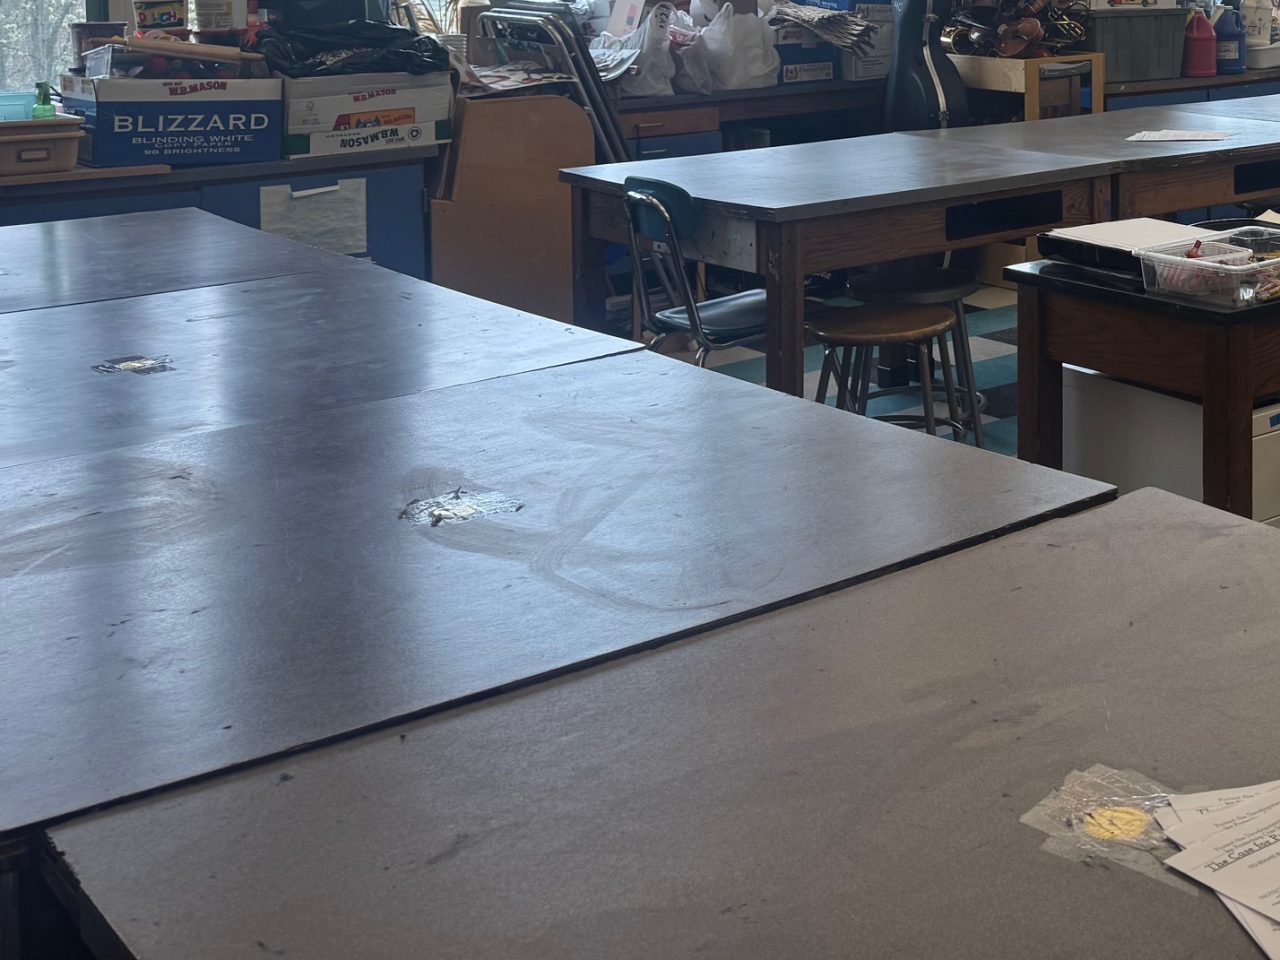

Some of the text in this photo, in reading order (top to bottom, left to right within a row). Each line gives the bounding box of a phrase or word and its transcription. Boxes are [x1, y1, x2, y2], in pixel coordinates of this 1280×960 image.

[114, 114, 268, 133] BLIZZARD
[132, 134, 253, 144] BLINDING WHITE
[1204, 859, 1231, 871] The
[1228, 847, 1256, 860] Case
[1253, 837, 1273, 848] for
